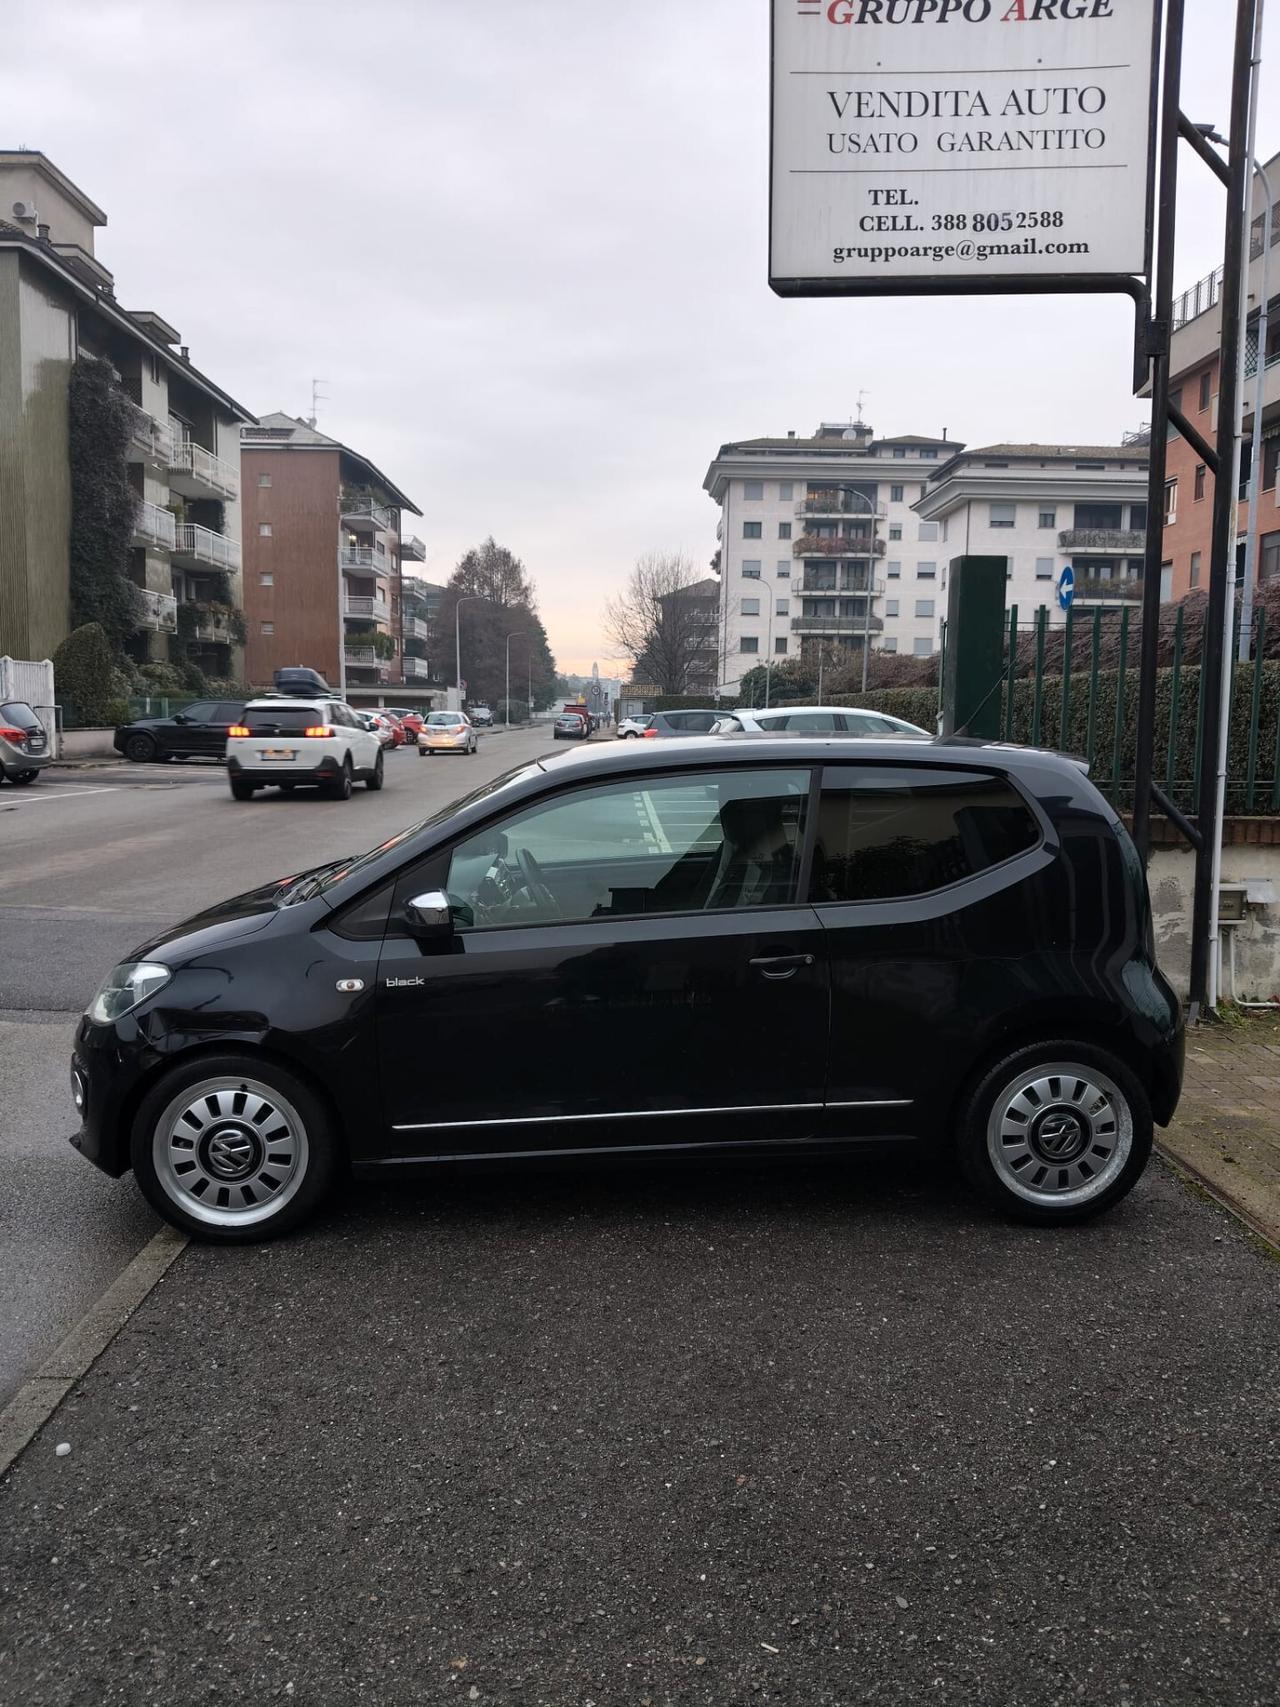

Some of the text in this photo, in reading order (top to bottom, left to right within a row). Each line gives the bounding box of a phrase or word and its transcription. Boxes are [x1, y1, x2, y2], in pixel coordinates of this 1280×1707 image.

[827, 0, 1113, 25] GRUPPO ARGE
[827, 86, 1106, 119] VENDITA AUTO
[827, 128, 1106, 154] USATO GARANTITO
[868, 189, 919, 206] TEL.
[859, 214, 925, 232] CELL.
[931, 214, 967, 231] 388
[833, 238, 1089, 263] gruppoarge@gmail.com
[386, 976, 425, 987] black
